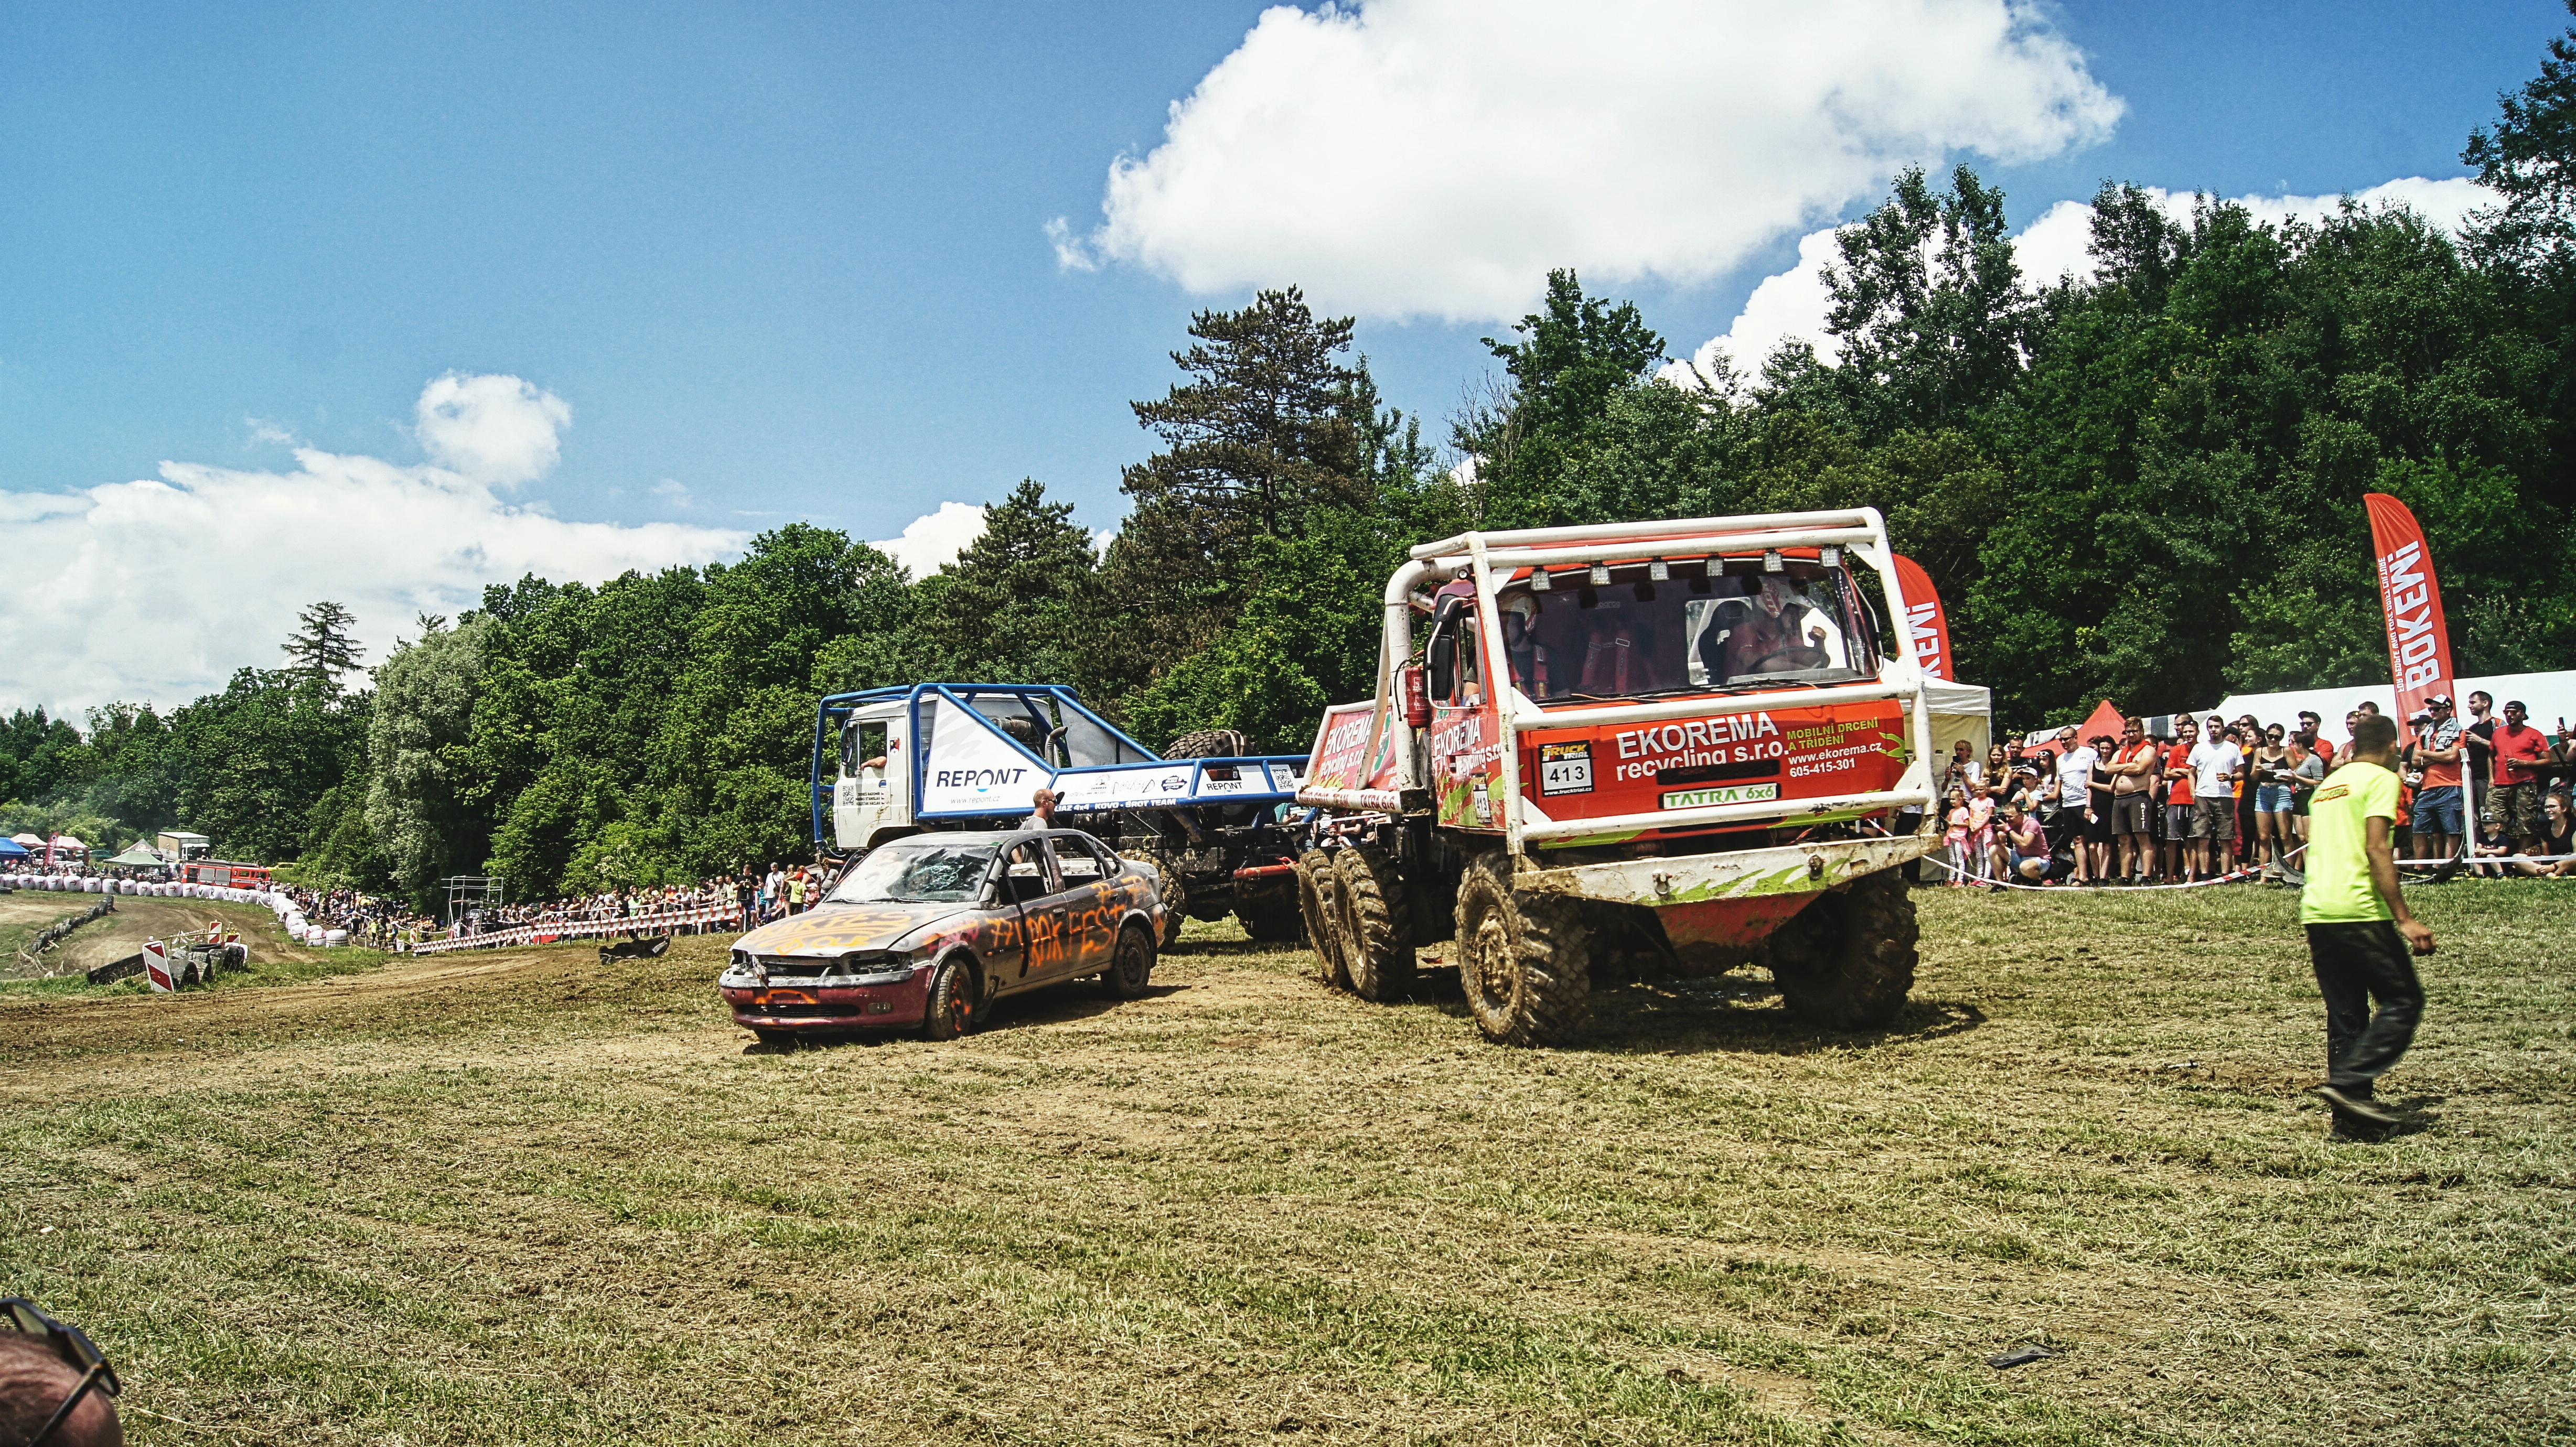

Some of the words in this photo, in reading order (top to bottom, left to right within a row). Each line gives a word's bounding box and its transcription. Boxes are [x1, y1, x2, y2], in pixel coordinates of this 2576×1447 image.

[1323, 713, 1374, 758] EKOREMA
[1434, 716, 1481, 761] EKOREMA
[1616, 712, 1779, 759] EKOREMA
[1787, 723, 1834, 740] MOBILNÍ
[1838, 717, 1879, 733] DRCENÍ
[1542, 744, 1587, 757] TRUCK
[1734, 741, 1789, 763] s.r.o.
[1789, 742, 1797, 751] A
[1799, 733, 1845, 749] TŘÍDĚNÍ
[1563, 751, 1589, 760] TRIAL
[1788, 742, 1882, 765] www.ekorema.cz
[1318, 751, 1349, 780] recycling
[1550, 766, 1584, 783] 413
[1789, 758, 1855, 778] 605-415-301
[936, 769, 1027, 792] REPONT
[1206, 782, 1242, 792] REPONT
[951, 795, 1001, 804] www.repont.cz
[1360, 794, 1380, 809] TATRA
[1544, 787, 1592, 796] www.trucktrial.cz
[1666, 789, 1738, 807] TATRA
[1746, 785, 1774, 800] 6x6
